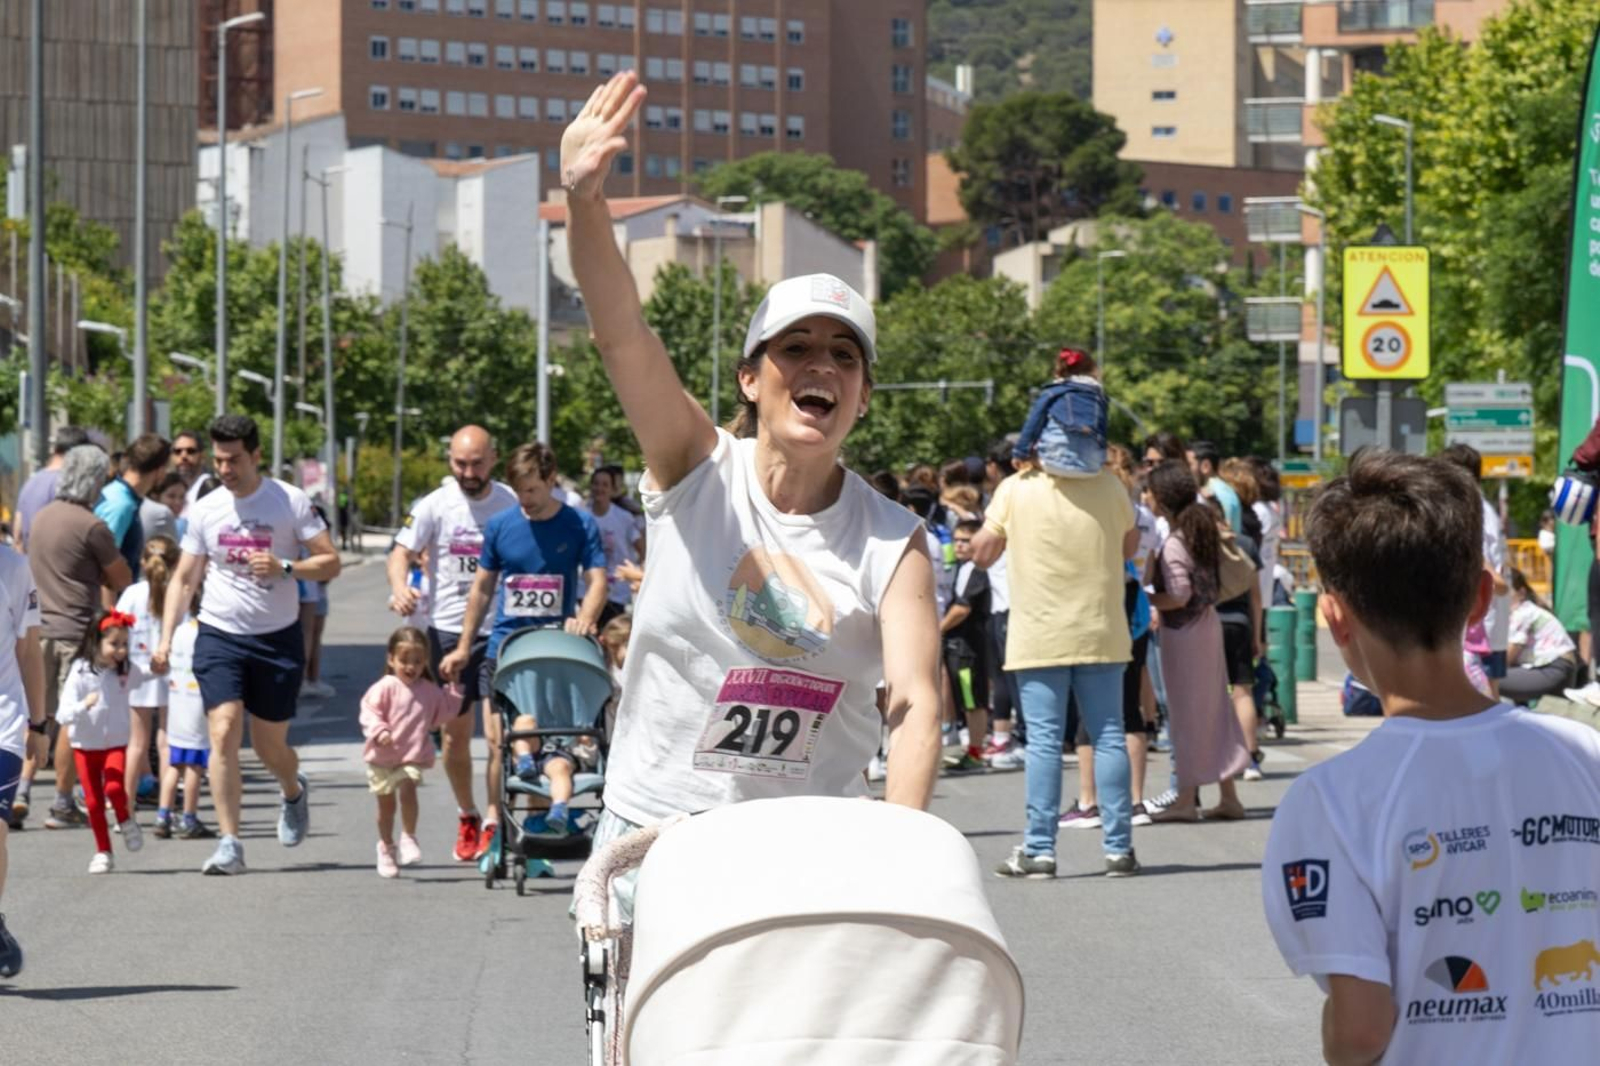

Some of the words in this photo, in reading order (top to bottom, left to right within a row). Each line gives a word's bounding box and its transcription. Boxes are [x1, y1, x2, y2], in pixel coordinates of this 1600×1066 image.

[1371, 337, 1402, 353] 20
[513, 590, 556, 609] 220
[714, 704, 801, 756] 219
[1406, 994, 1508, 1018] neumax
